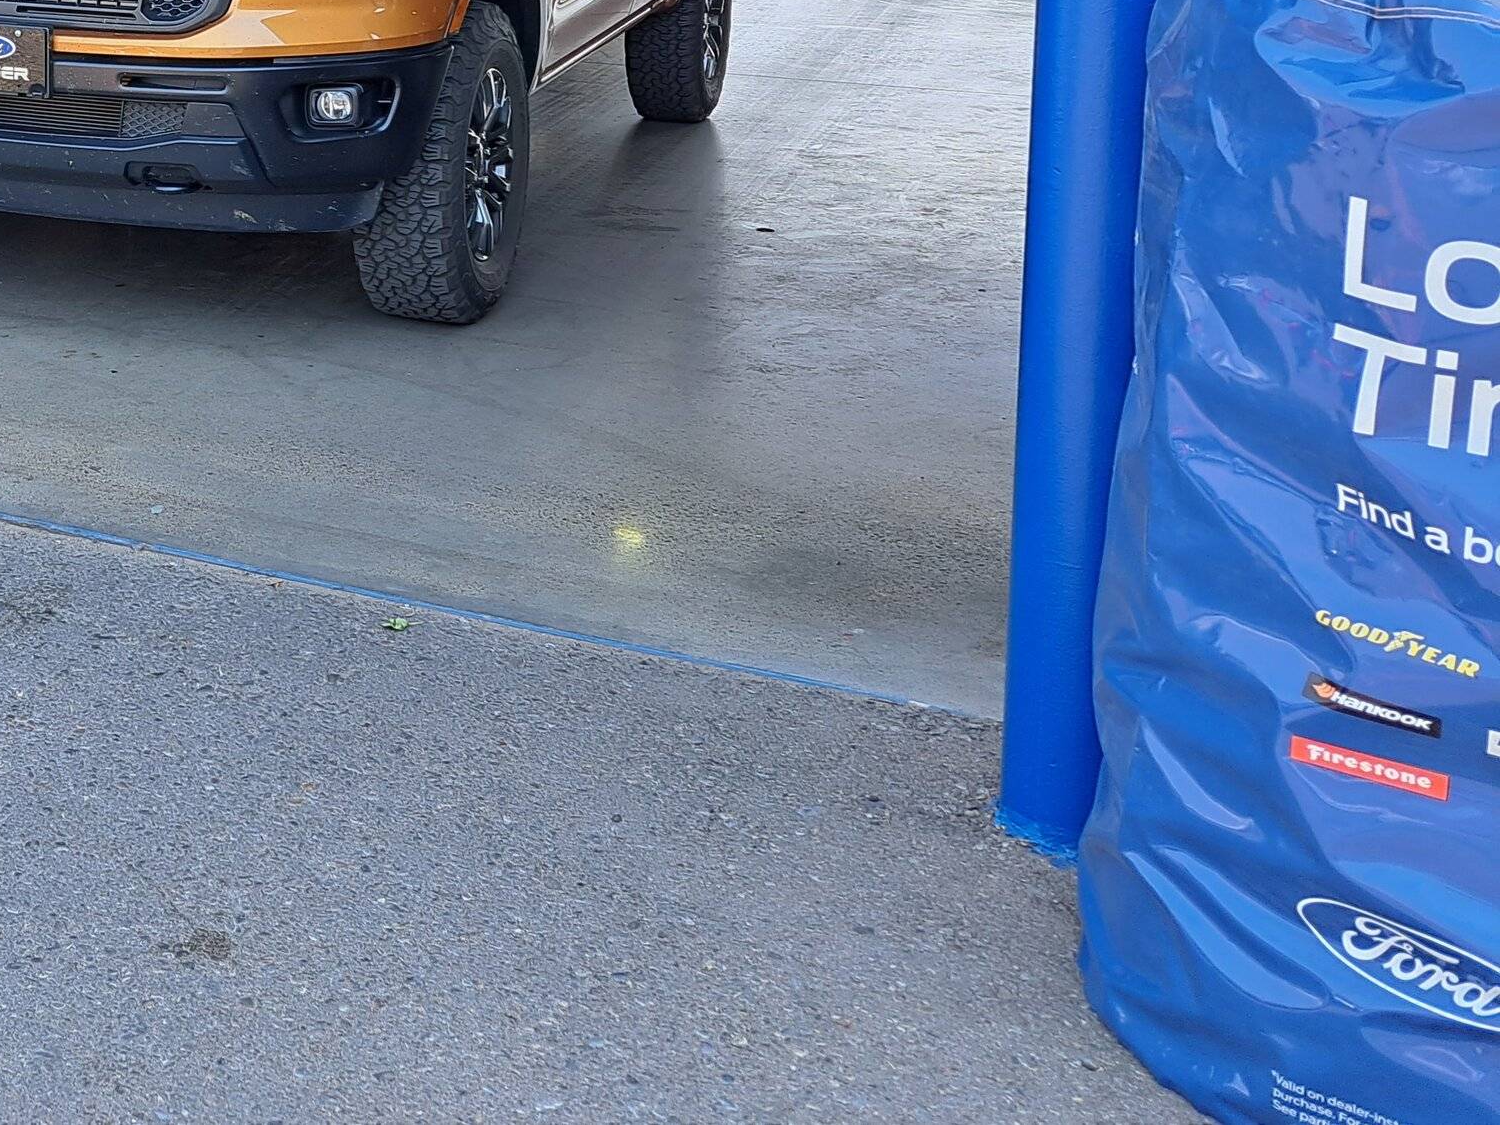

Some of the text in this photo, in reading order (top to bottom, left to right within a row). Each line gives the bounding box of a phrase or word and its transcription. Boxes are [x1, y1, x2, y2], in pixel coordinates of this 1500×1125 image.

[1336, 482, 1500, 565] Find a b
[1307, 744, 1432, 790] Firestone
[1342, 916, 1500, 1017] Ford
[1272, 1087, 1336, 1120] purchase.
[1272, 1099, 1297, 1117] See
[1307, 1089, 1325, 1103] on
